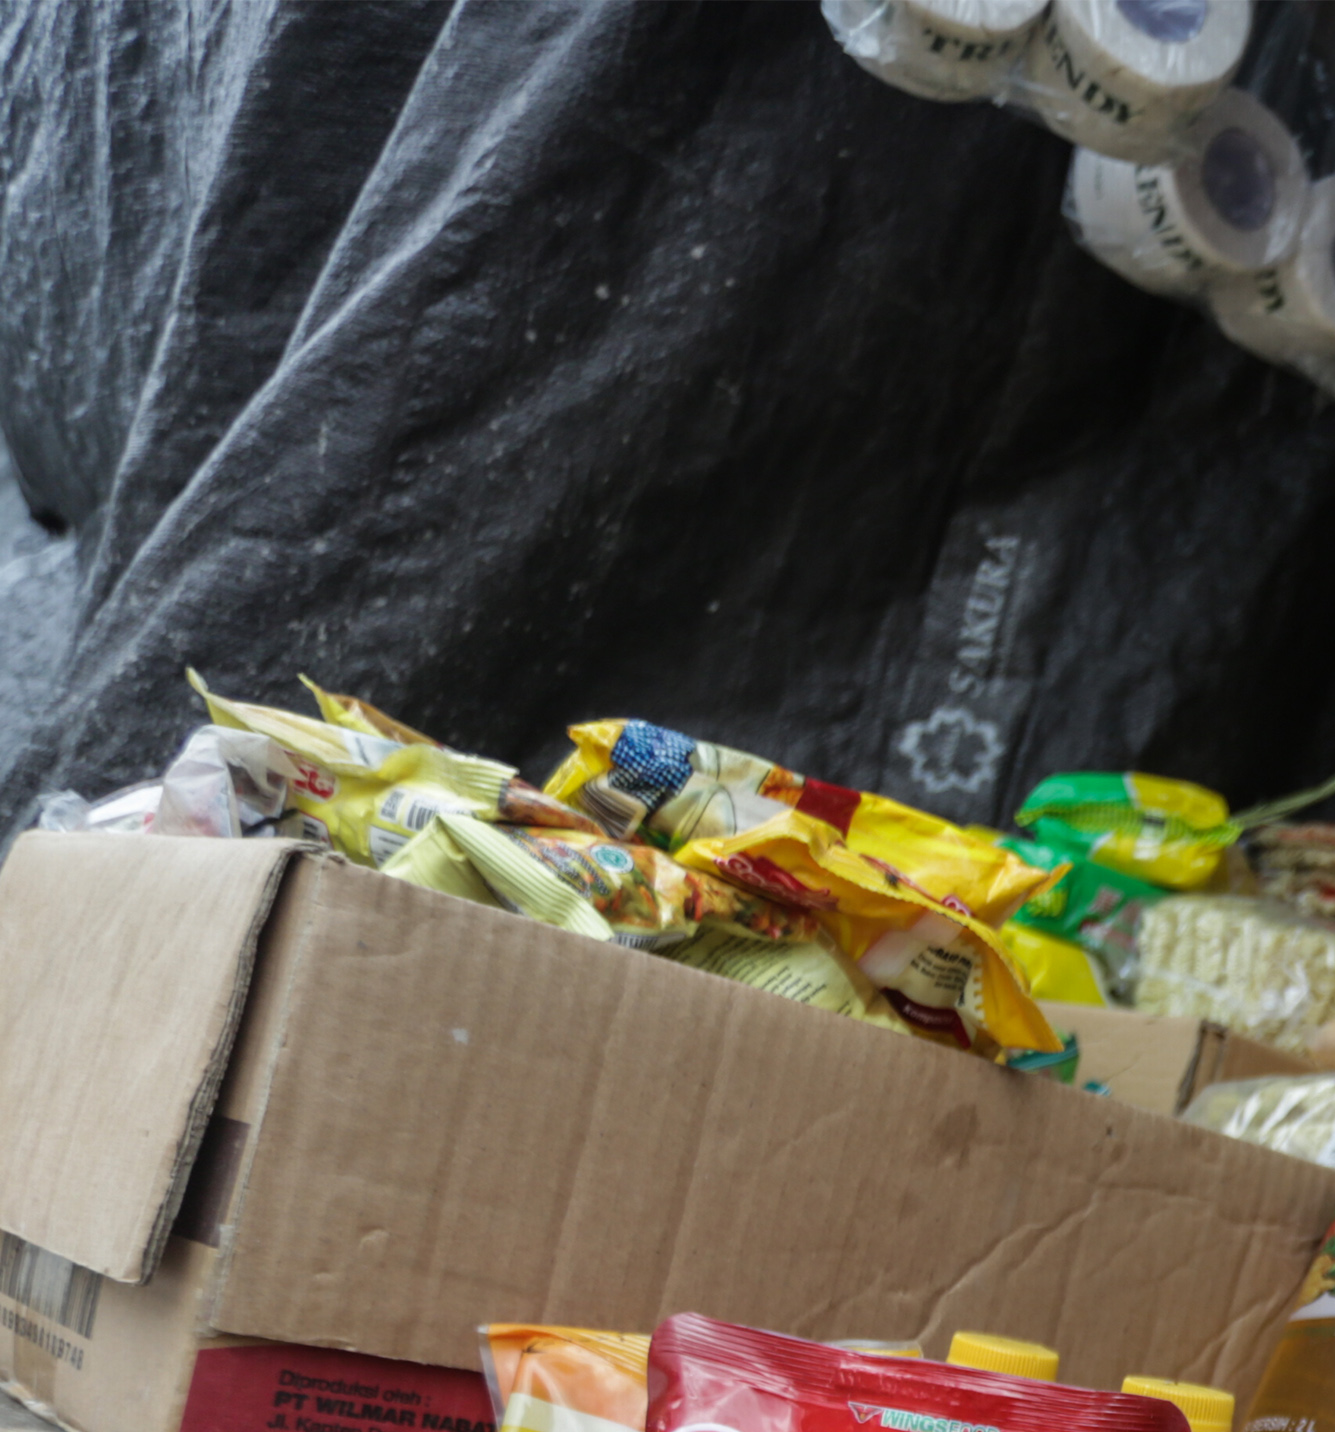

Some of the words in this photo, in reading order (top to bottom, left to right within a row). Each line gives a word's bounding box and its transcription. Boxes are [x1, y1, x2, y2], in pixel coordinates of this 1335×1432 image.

[949, 537, 1020, 699] SAKURA
[273, 1391, 308, 1411] PT
[316, 1394, 416, 1428] WILMAR
